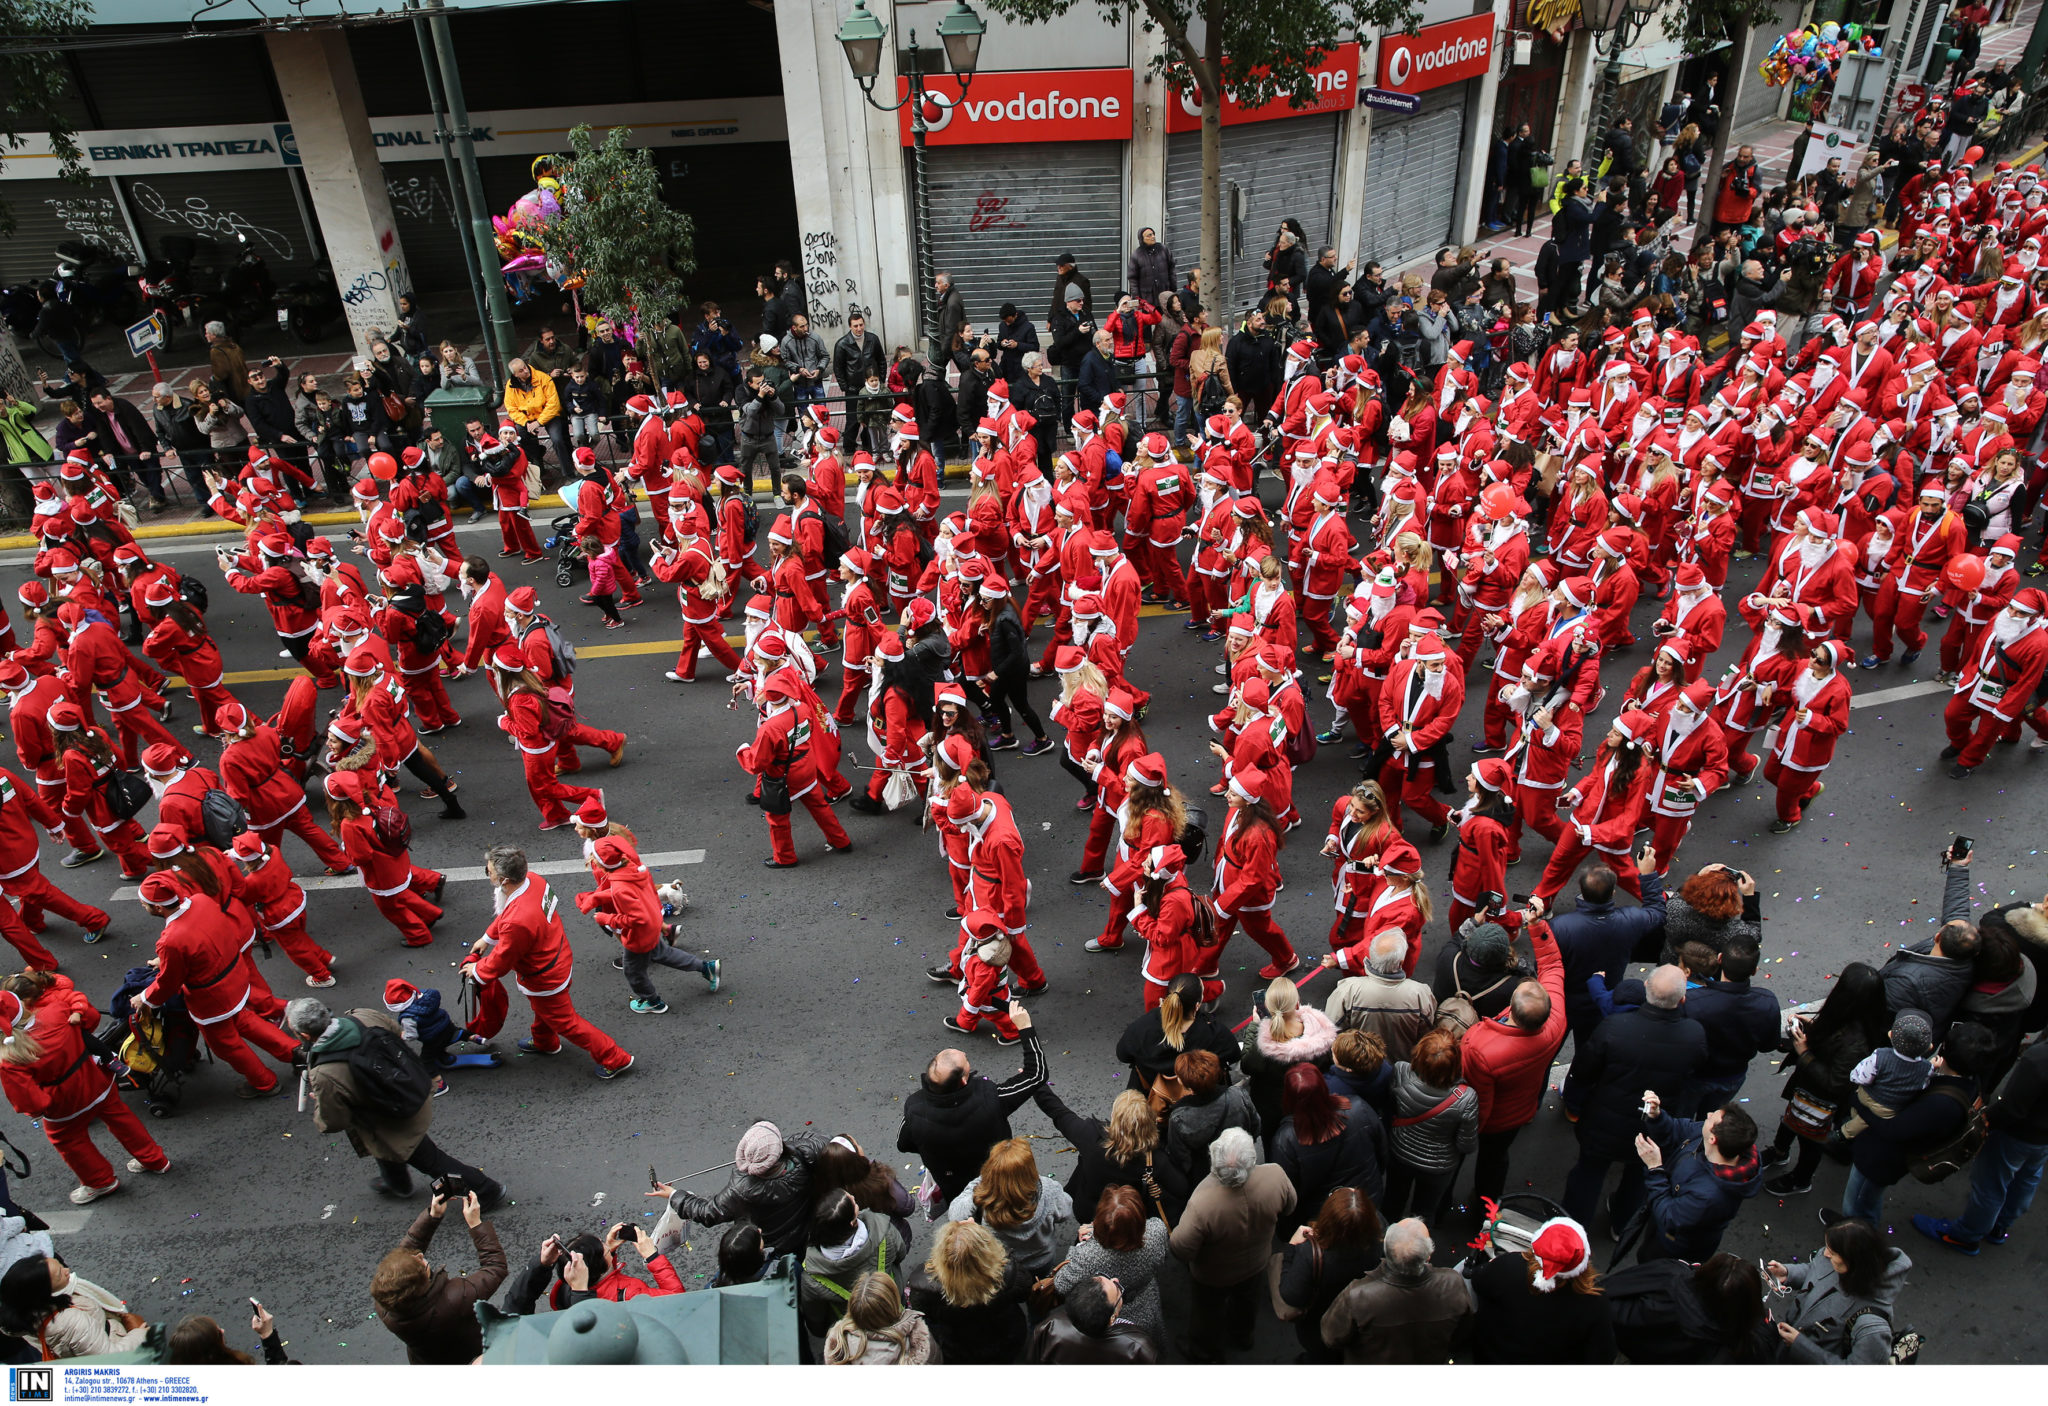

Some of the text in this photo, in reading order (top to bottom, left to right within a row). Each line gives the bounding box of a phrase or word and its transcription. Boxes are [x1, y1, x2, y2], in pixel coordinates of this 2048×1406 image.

[1415, 36, 1488, 73] vodafone
[963, 90, 1120, 122] vodafone
[1338, 94, 1346, 107] 3
[372, 130, 431, 147] ONAL
[698, 126, 739, 137] GROUP
[88, 139, 276, 162] ΕΘΝΙΚΗ ΤΡΑΠΕΖΑ
